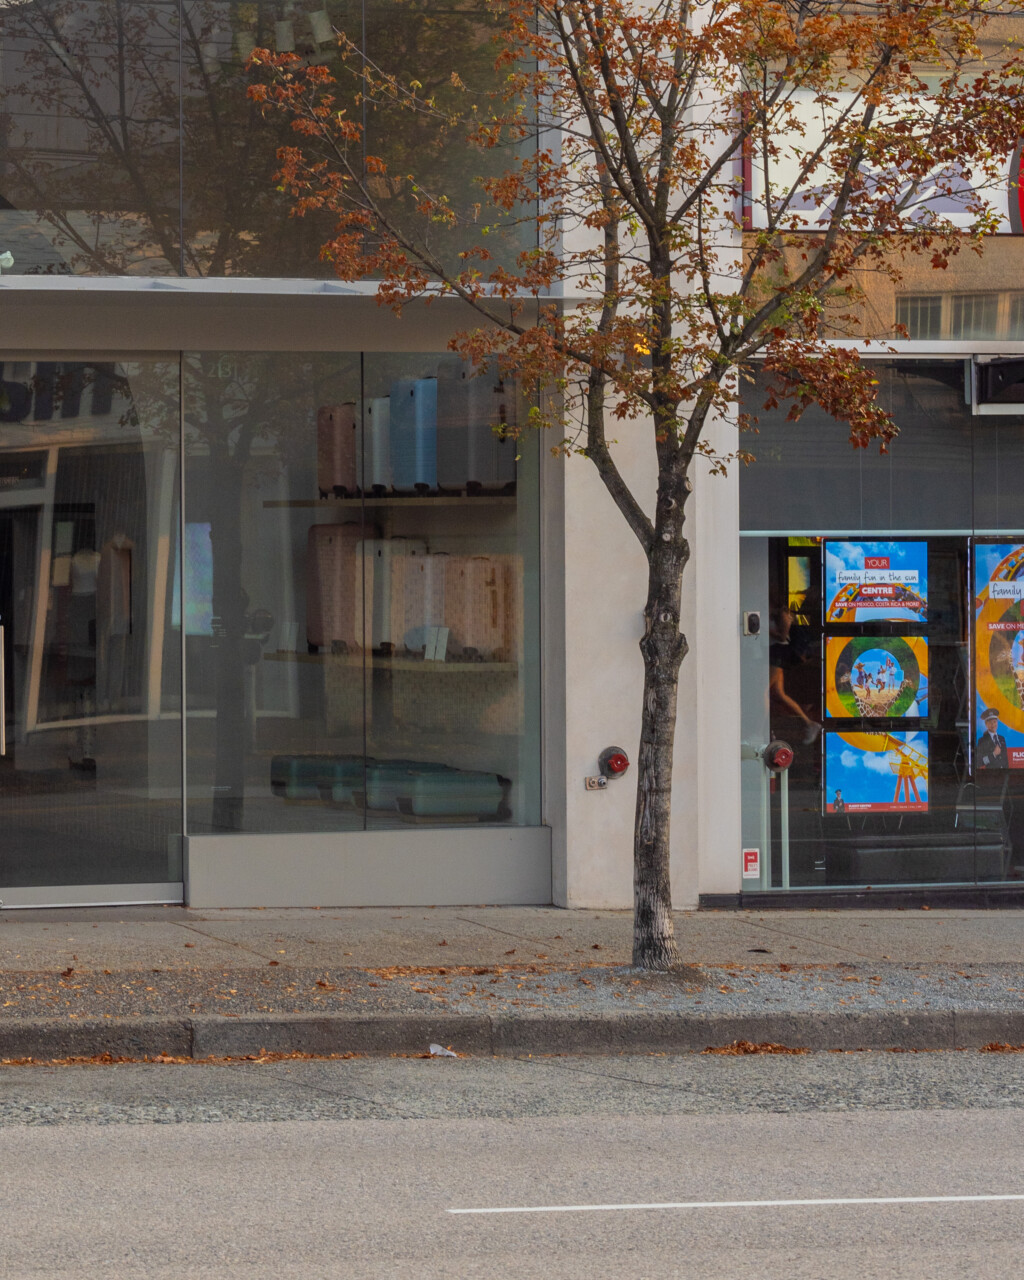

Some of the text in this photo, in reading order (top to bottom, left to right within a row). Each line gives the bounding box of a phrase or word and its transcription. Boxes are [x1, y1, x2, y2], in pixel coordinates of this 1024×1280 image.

[867, 559, 888, 567] YOUR
[838, 571, 861, 587] family
[864, 571, 877, 586] fun
[888, 571, 902, 581] the
[992, 582, 1022, 601] family
